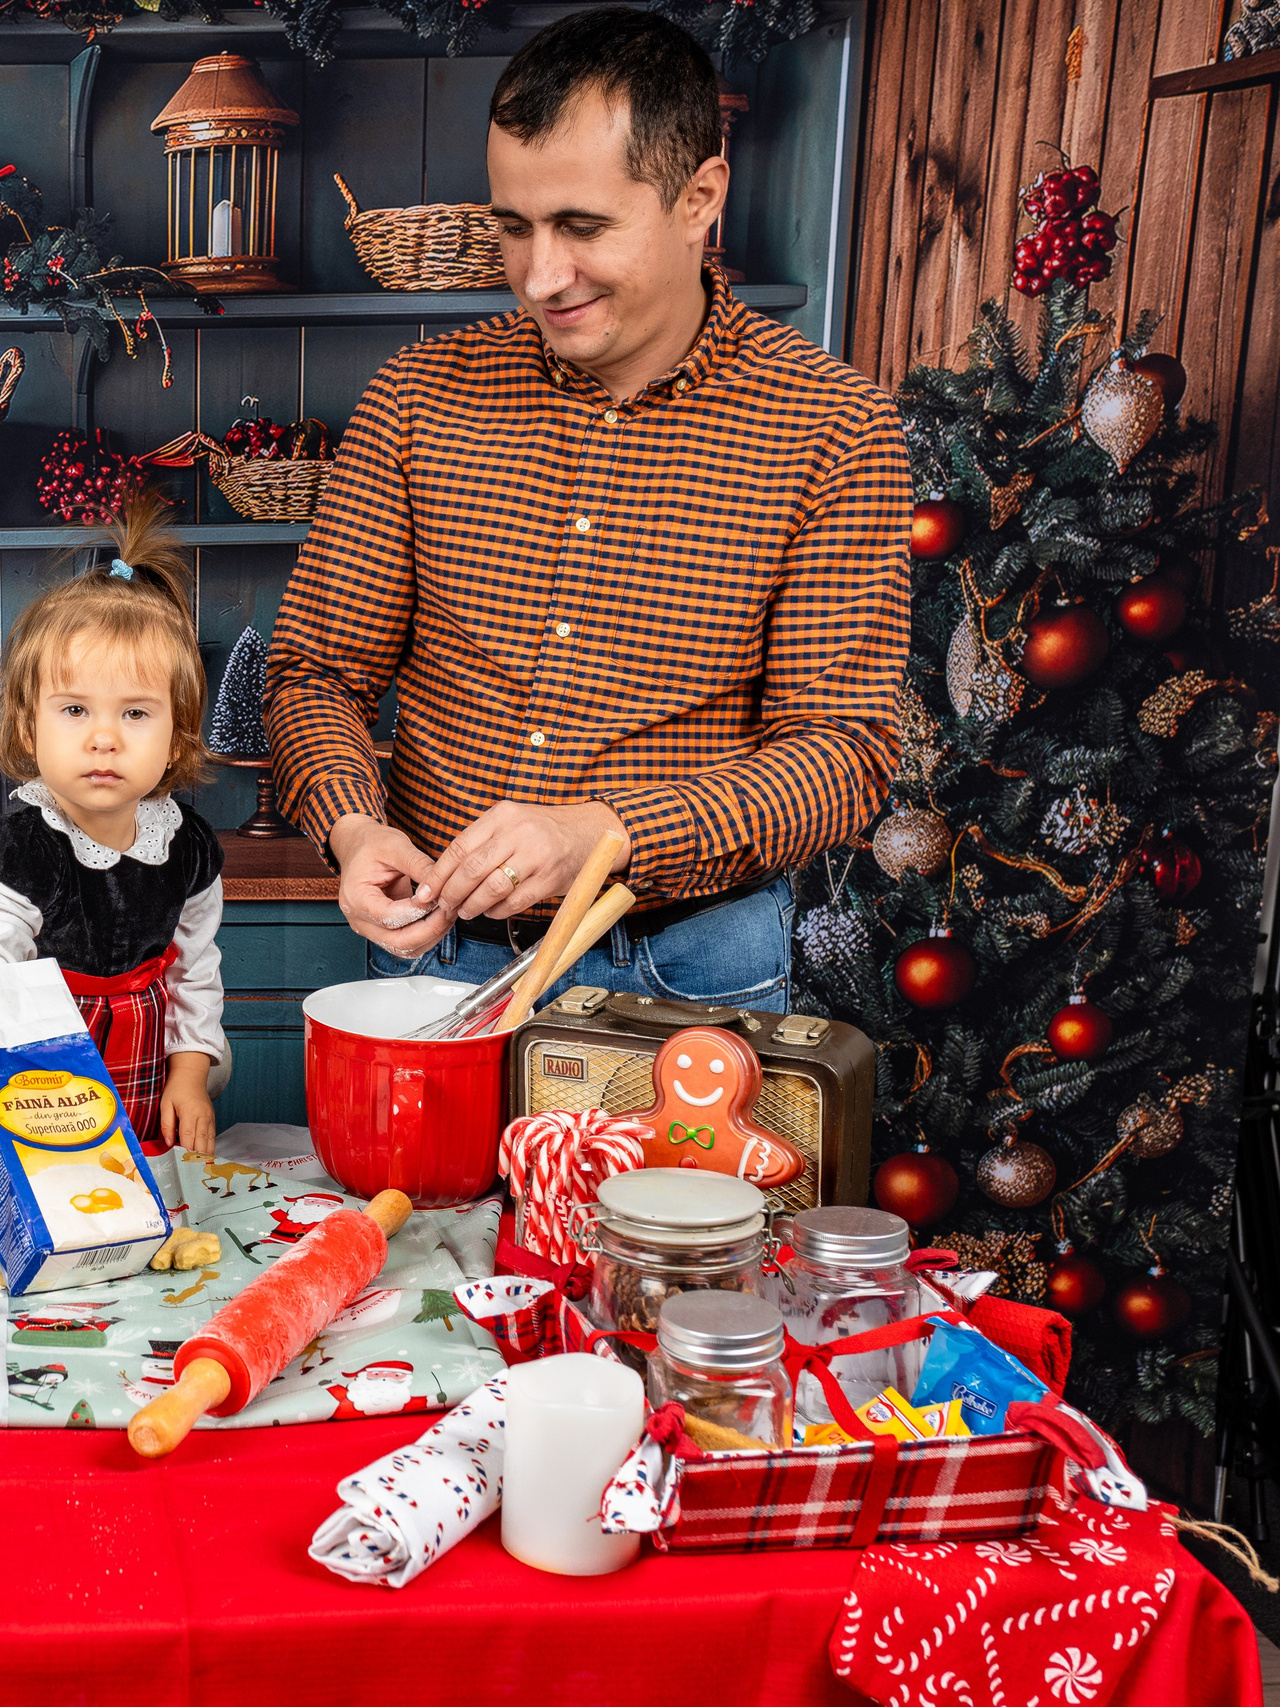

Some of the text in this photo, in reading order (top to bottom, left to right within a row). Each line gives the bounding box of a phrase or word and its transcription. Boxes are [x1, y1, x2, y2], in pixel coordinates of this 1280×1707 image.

[546, 1059, 580, 1077] RADIO
[14, 1073, 65, 1087] Boromir
[34, 1111, 52, 1120] din
[25, 1117, 96, 1136] Superioară 000
[287, 1154, 318, 1167] CHRIST
